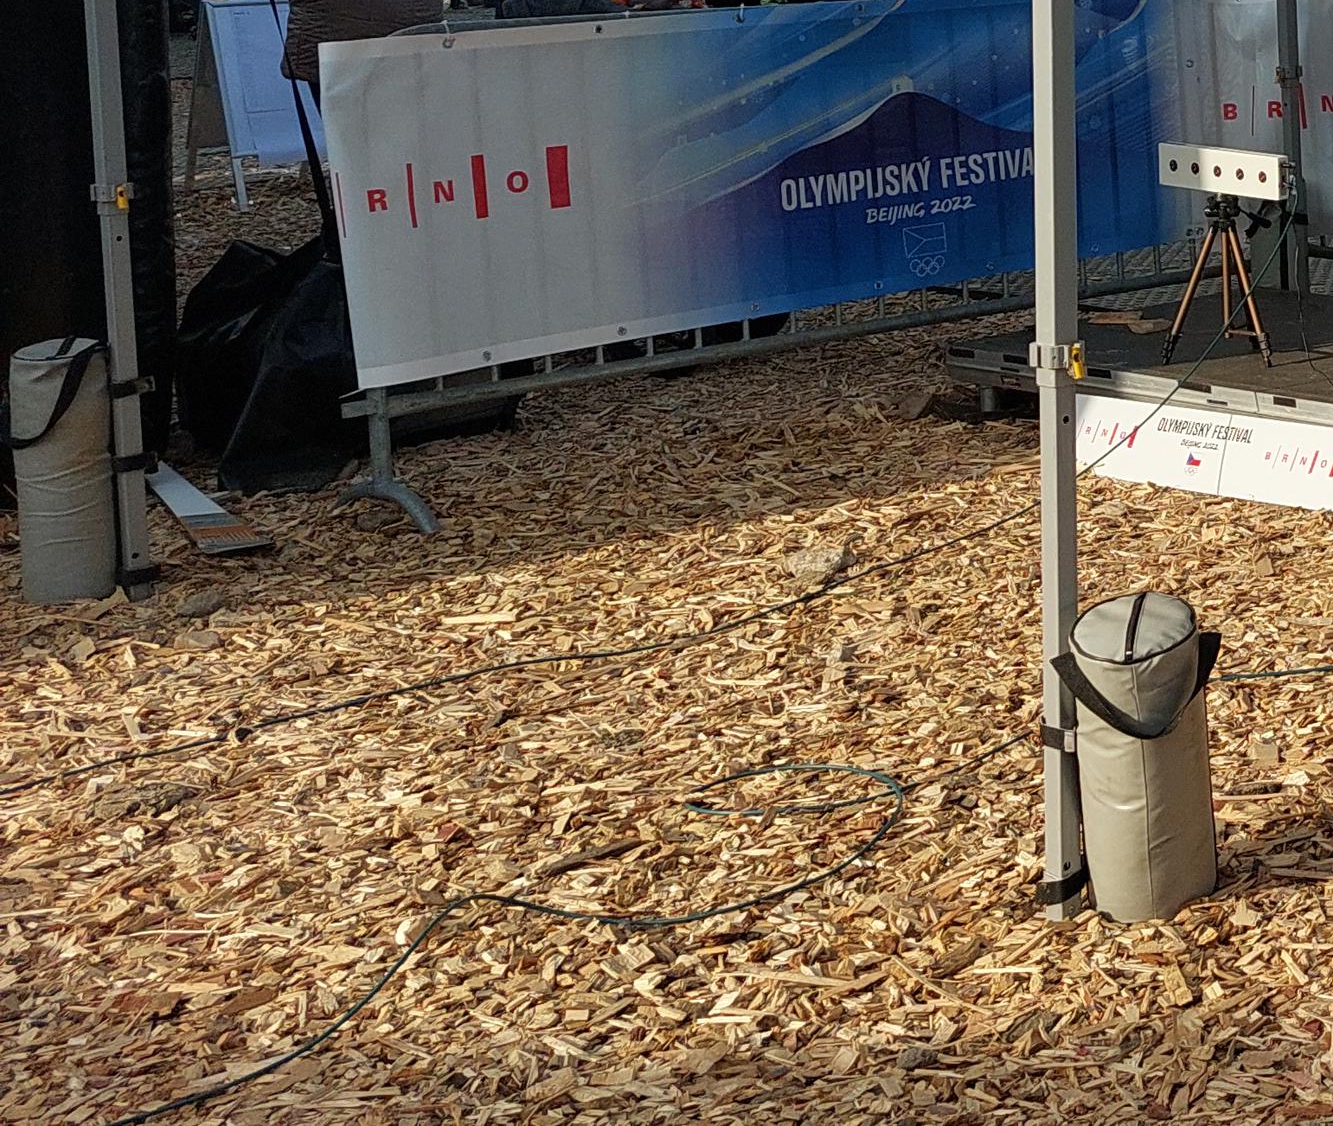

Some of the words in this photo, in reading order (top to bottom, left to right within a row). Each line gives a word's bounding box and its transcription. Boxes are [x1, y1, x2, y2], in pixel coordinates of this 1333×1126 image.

[780, 156, 932, 212] OLYMPIJSKÝ
[939, 146, 1034, 191] FESTIVA
[865, 202, 924, 225] BEIJING
[930, 193, 977, 214] 2022
[1157, 417, 1211, 437] OLYMPIJSKÝ
[1211, 424, 1254, 444] FESTIVAL
